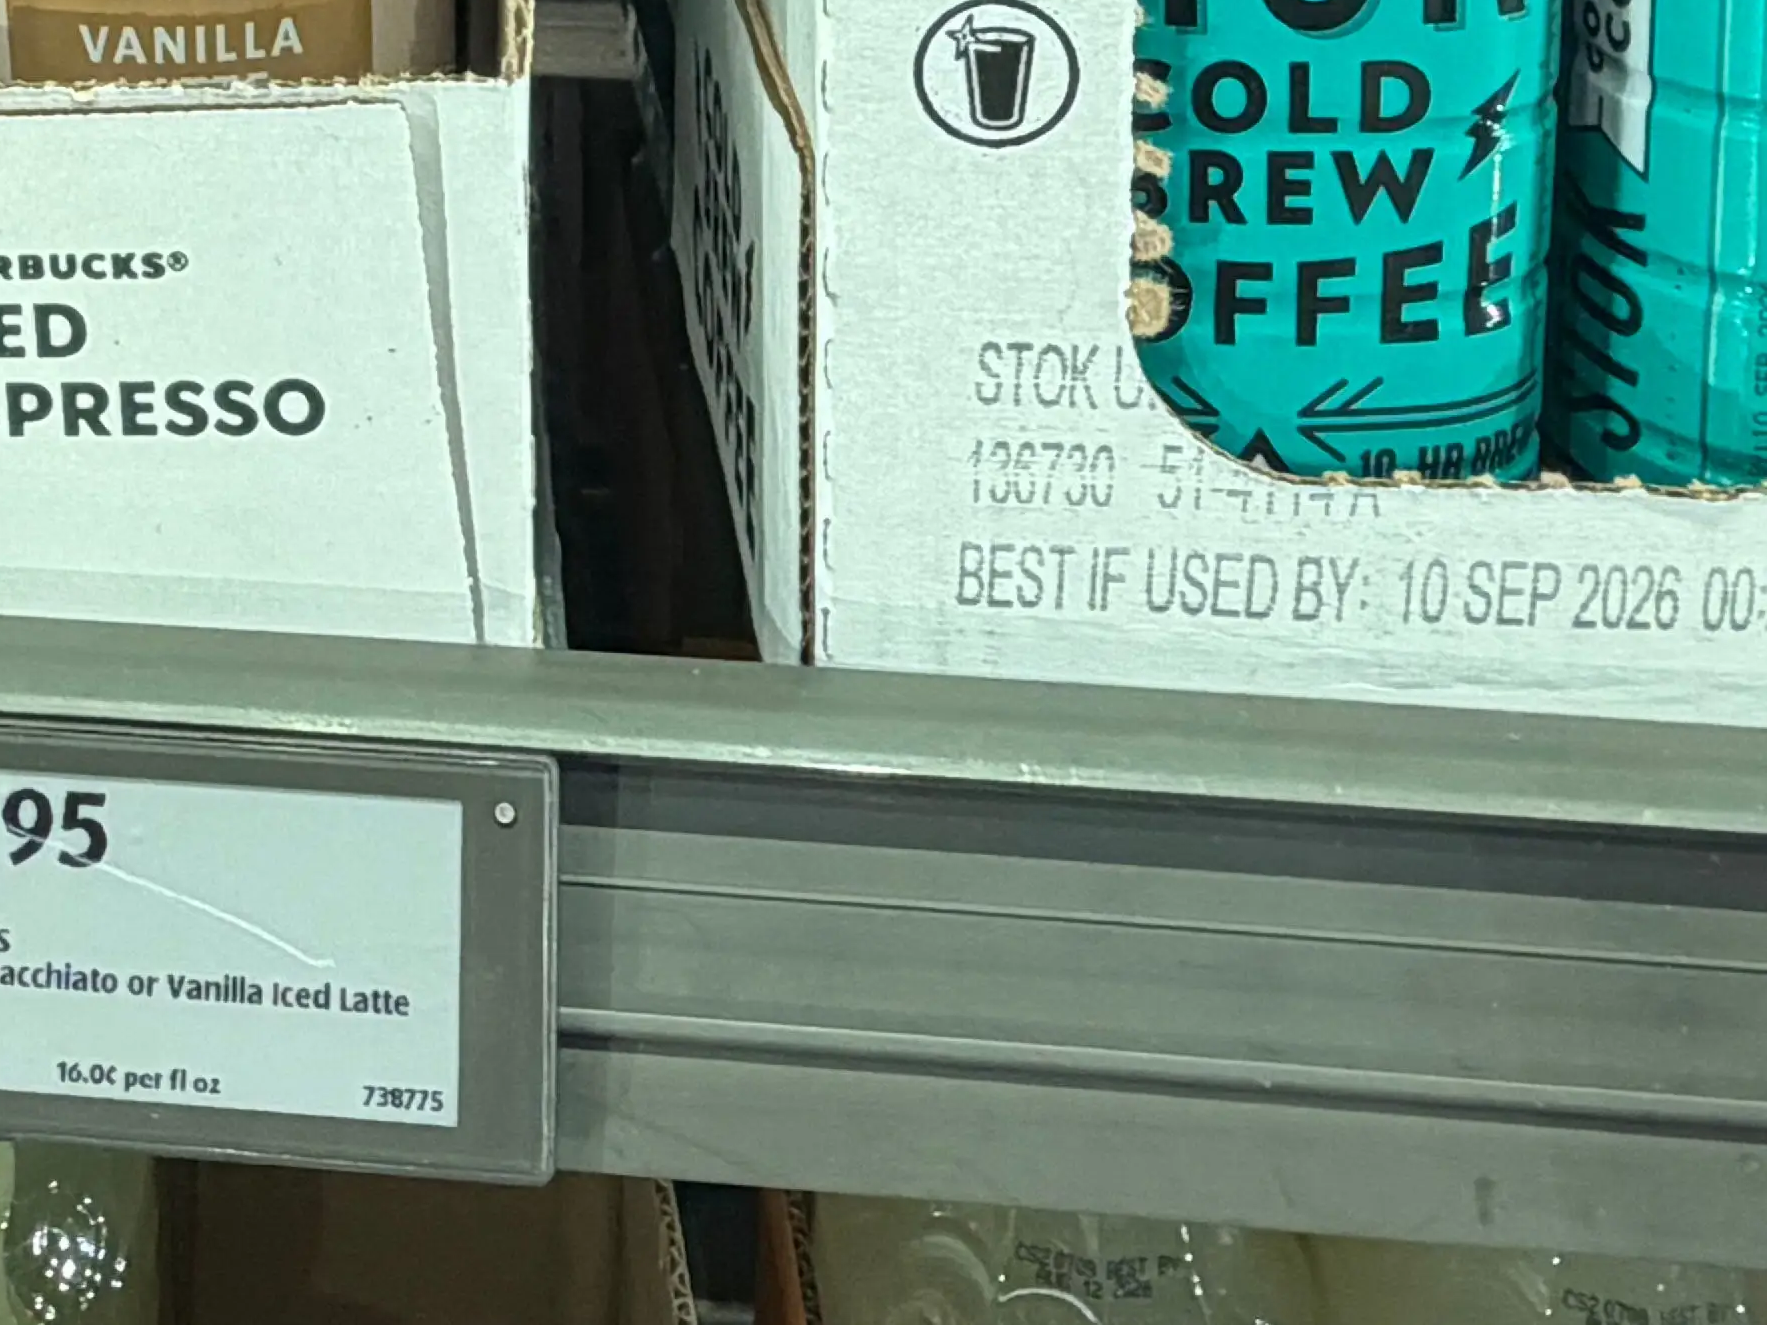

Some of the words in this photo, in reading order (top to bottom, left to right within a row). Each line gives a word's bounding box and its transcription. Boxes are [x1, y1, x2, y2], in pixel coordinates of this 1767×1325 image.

[78, 16, 304, 65] VANILLA
[973, 340, 1100, 411] STOK
[954, 540, 1078, 611] BEST
[1087, 545, 1132, 612] IF
[1145, 546, 1280, 620] USED
[1292, 554, 1371, 624] BY:
[1399, 558, 1449, 625] 10
[1462, 559, 1563, 627] SEP
[1571, 562, 1683, 631] 2026
[127, 976, 160, 998] or
[166, 972, 264, 1006] Vanilla
[272, 980, 332, 1011] Iced
[339, 985, 411, 1017] Latte
[123, 1072, 164, 1094] per
[168, 1068, 187, 1092] fl
[193, 1076, 222, 1095] oz
[361, 1084, 446, 1113] 738775
